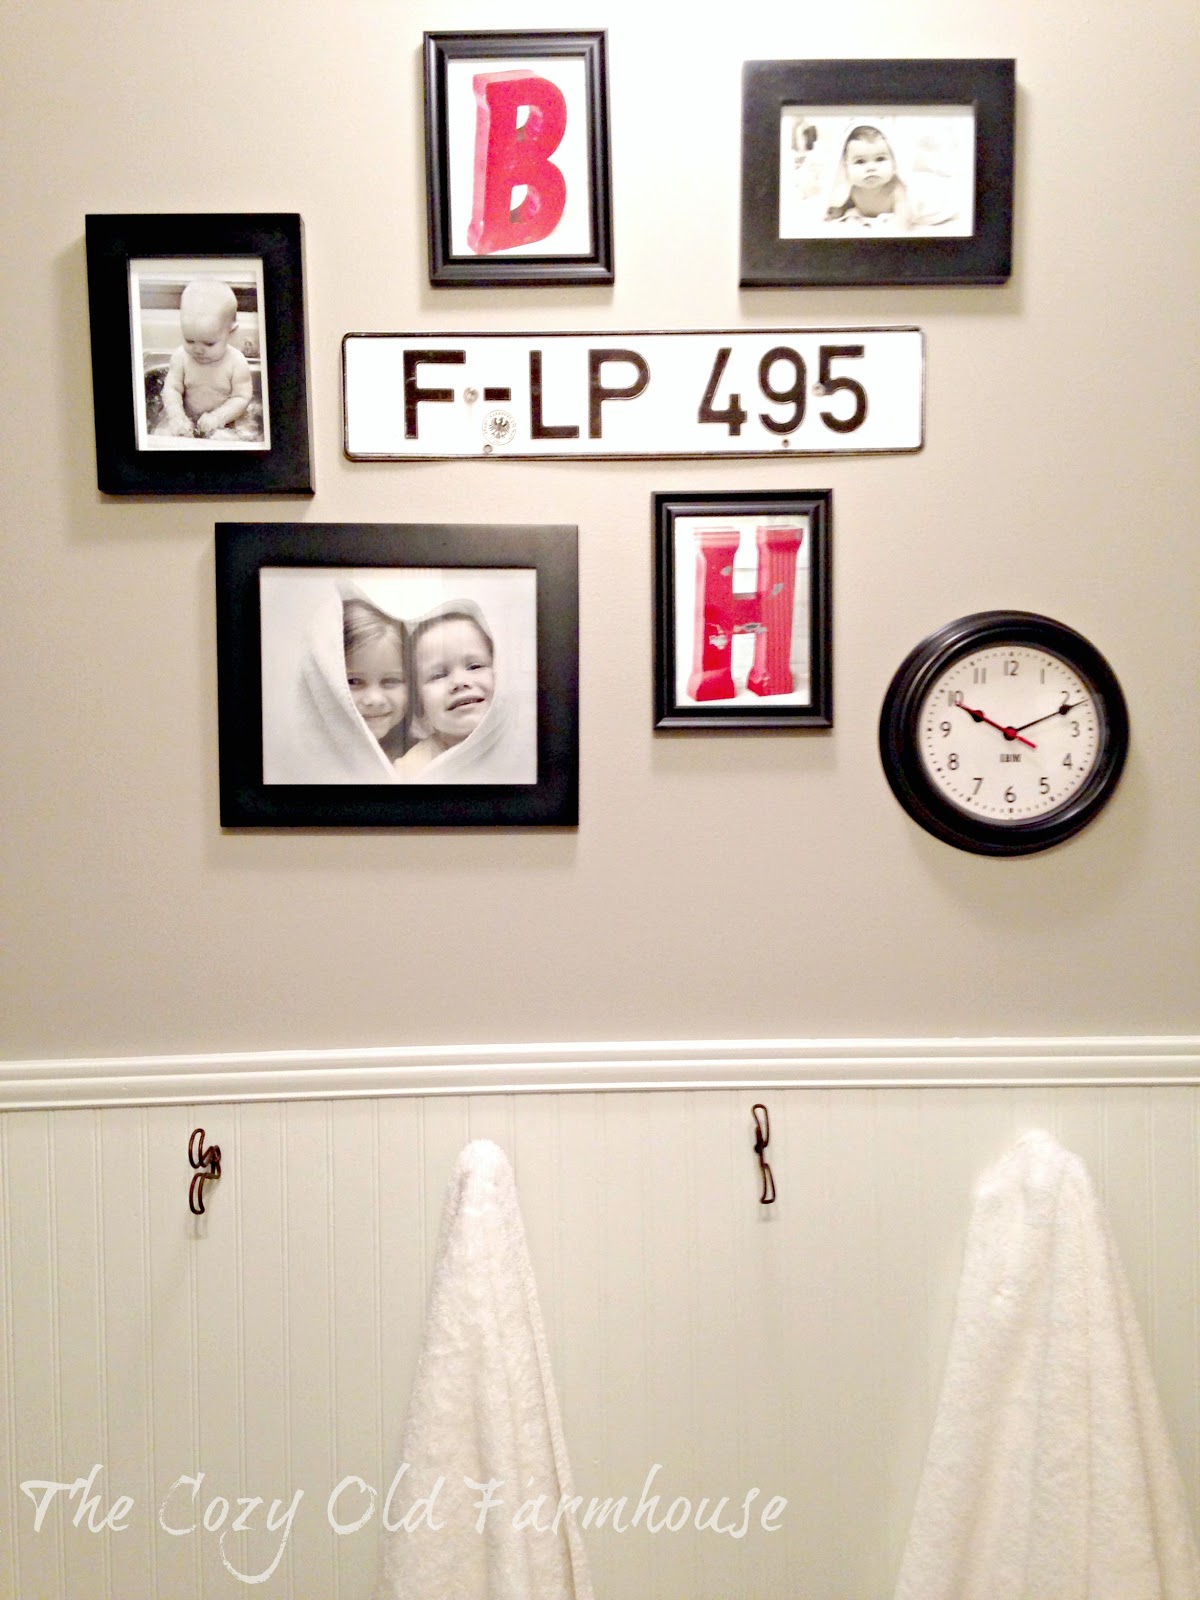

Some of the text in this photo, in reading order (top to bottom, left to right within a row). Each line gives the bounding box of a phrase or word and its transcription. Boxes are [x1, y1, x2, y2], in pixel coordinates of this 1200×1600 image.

[467, 69, 567, 255] B
[697, 344, 869, 437] 495
[687, 525, 803, 701] H
[973, 667, 987, 684] 11
[1003, 660, 1020, 677] 12
[1040, 668, 1045, 684] 1
[947, 690, 964, 707] 10
[939, 721, 952, 738] 9
[1071, 721, 1081, 738] 3
[947, 753, 960, 771] 8
[1062, 753, 1073, 769] 4
[972, 777, 984, 795] 7
[1003, 786, 1017, 803] 6
[1040, 777, 1050, 795] 5
